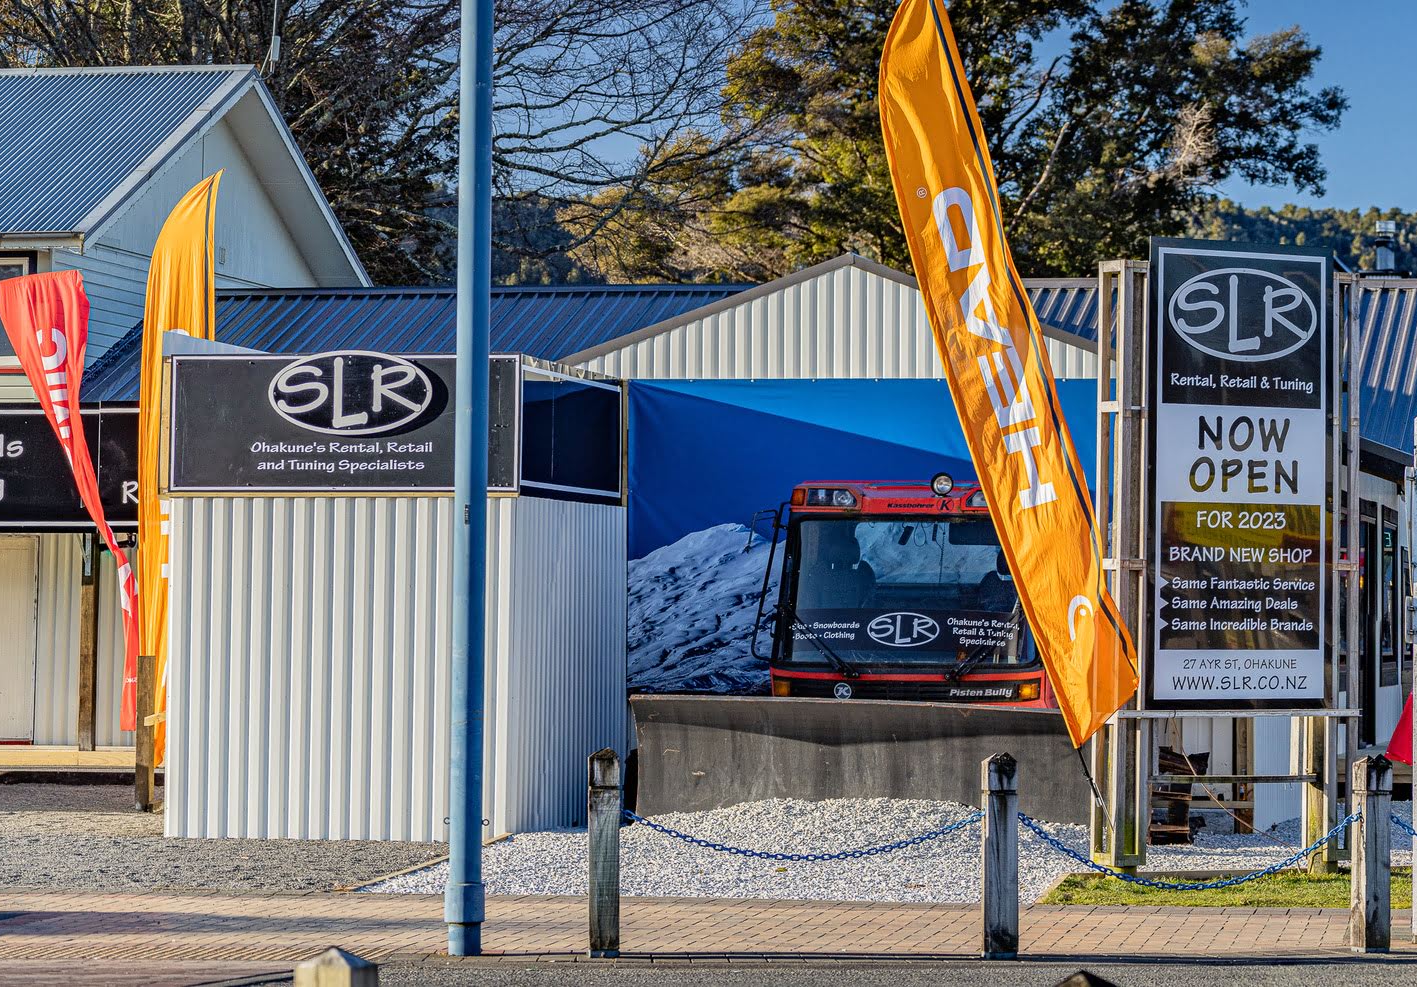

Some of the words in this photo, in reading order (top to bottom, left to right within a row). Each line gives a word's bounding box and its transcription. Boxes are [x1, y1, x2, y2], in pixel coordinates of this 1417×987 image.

[1177, 274, 1308, 353] SLR
[931, 186, 1057, 510] HEAD
[1170, 372, 1217, 389] Rental,
[1220, 374, 1257, 389] Retail
[1260, 376, 1270, 389] &
[1272, 376, 1314, 394] Tuning
[277, 356, 423, 428] SLR
[1198, 415, 1291, 453] NOW
[250, 441, 326, 454] Ohakune's
[329, 441, 383, 457] Rental,
[387, 440, 433, 454] Retail
[256, 458, 285, 471] and
[287, 458, 335, 474] Tuning
[338, 457, 425, 474] Specialists
[1188, 455, 1299, 495] OPEN
[1196, 510, 1234, 529] FOR
[1238, 511, 1286, 530] 2023
[1169, 546, 1225, 562] BRAND
[1229, 547, 1265, 563] NEW
[1268, 548, 1313, 564] SHOP
[1171, 576, 1207, 590] Same
[1210, 577, 1270, 591] Fantastic
[1273, 577, 1316, 591] Service
[1171, 596, 1207, 610] Same
[1210, 596, 1262, 613] Amazing
[1265, 597, 1298, 610] Deals
[813, 621, 860, 629] Snowboards
[870, 614, 935, 644] SLR
[947, 617, 989, 628] Ohakune's
[1171, 617, 1207, 631] Same
[1210, 617, 1267, 632] Incredible
[1270, 618, 1313, 632] Brands
[824, 631, 855, 640] Clothing
[953, 627, 977, 636] Retail
[979, 628, 985, 636] &
[1183, 658, 1196, 670] 27
[1199, 658, 1221, 670] AYR
[1224, 659, 1241, 672] ST,
[1244, 658, 1297, 670] OHAKUNE
[1172, 675, 1308, 691] WWW.SLR.CO.NZ
[949, 688, 983, 697] Pisten
[984, 688, 1013, 698] Bully
